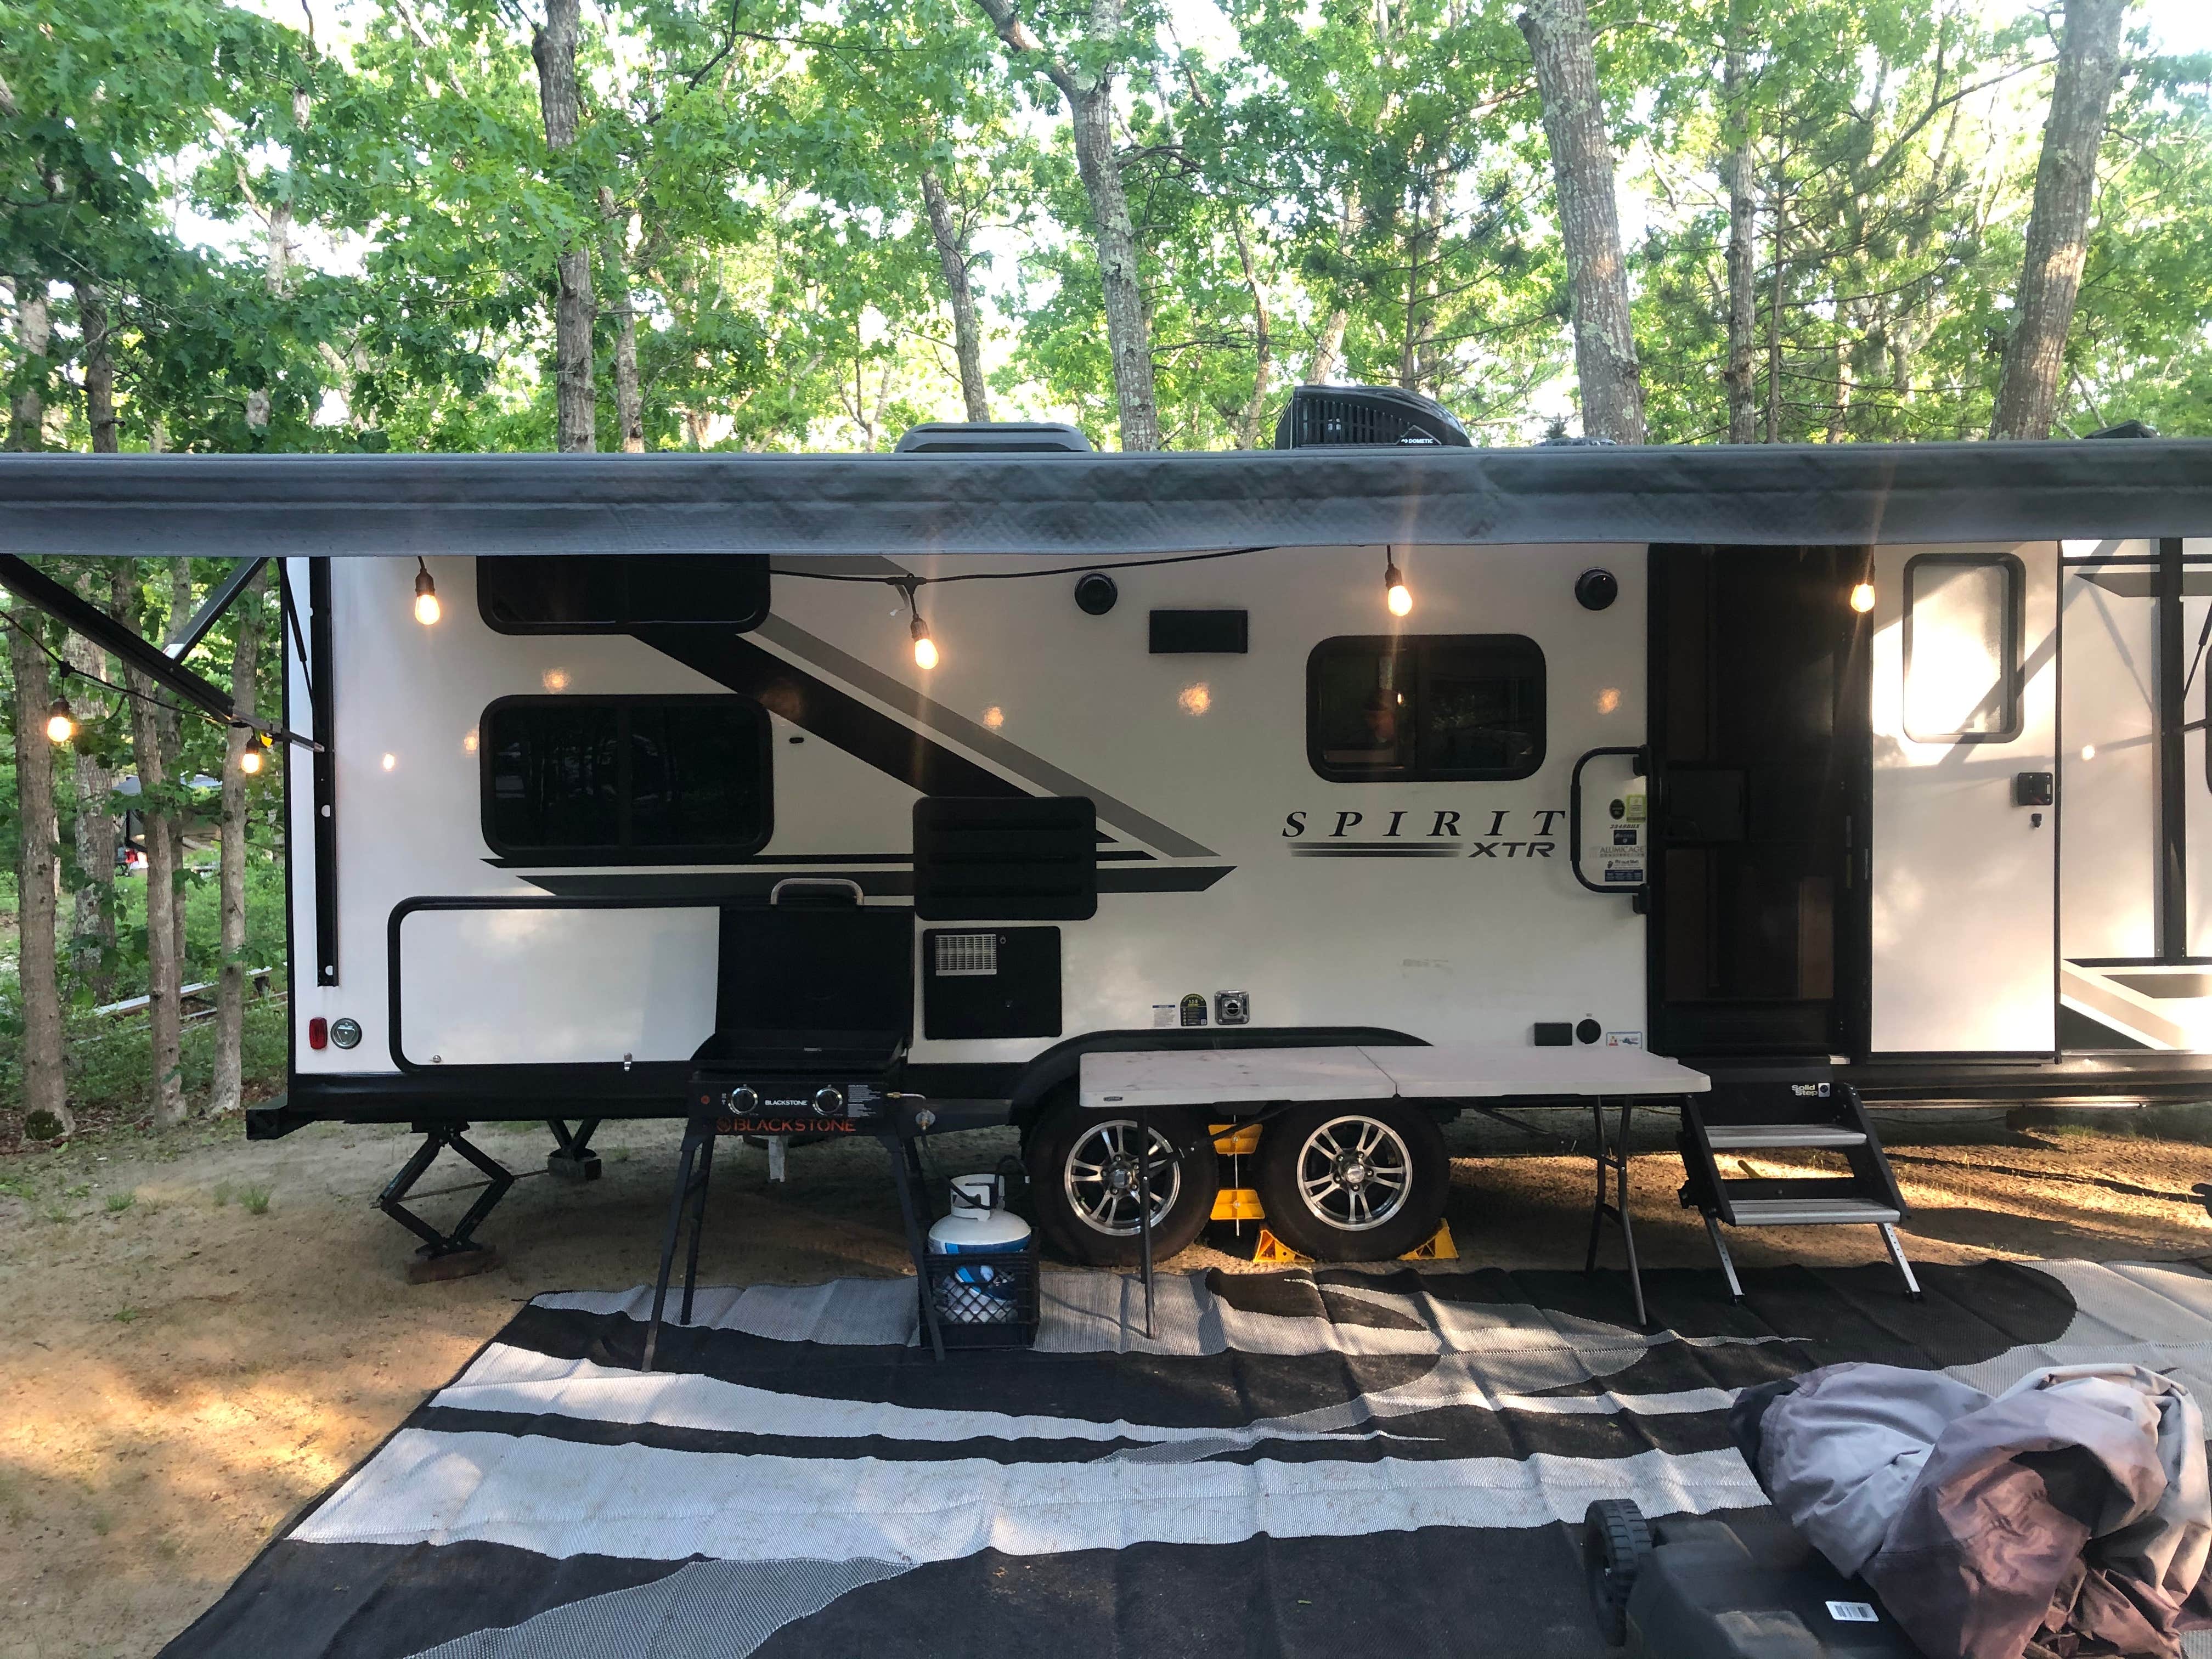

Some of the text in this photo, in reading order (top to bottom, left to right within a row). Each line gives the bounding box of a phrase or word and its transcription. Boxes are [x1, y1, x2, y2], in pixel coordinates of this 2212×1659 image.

[1282, 810, 1566, 838] SPIRIT
[1468, 842, 1555, 857] XTR
[734, 1118, 856, 1132] BLACKSTONE
